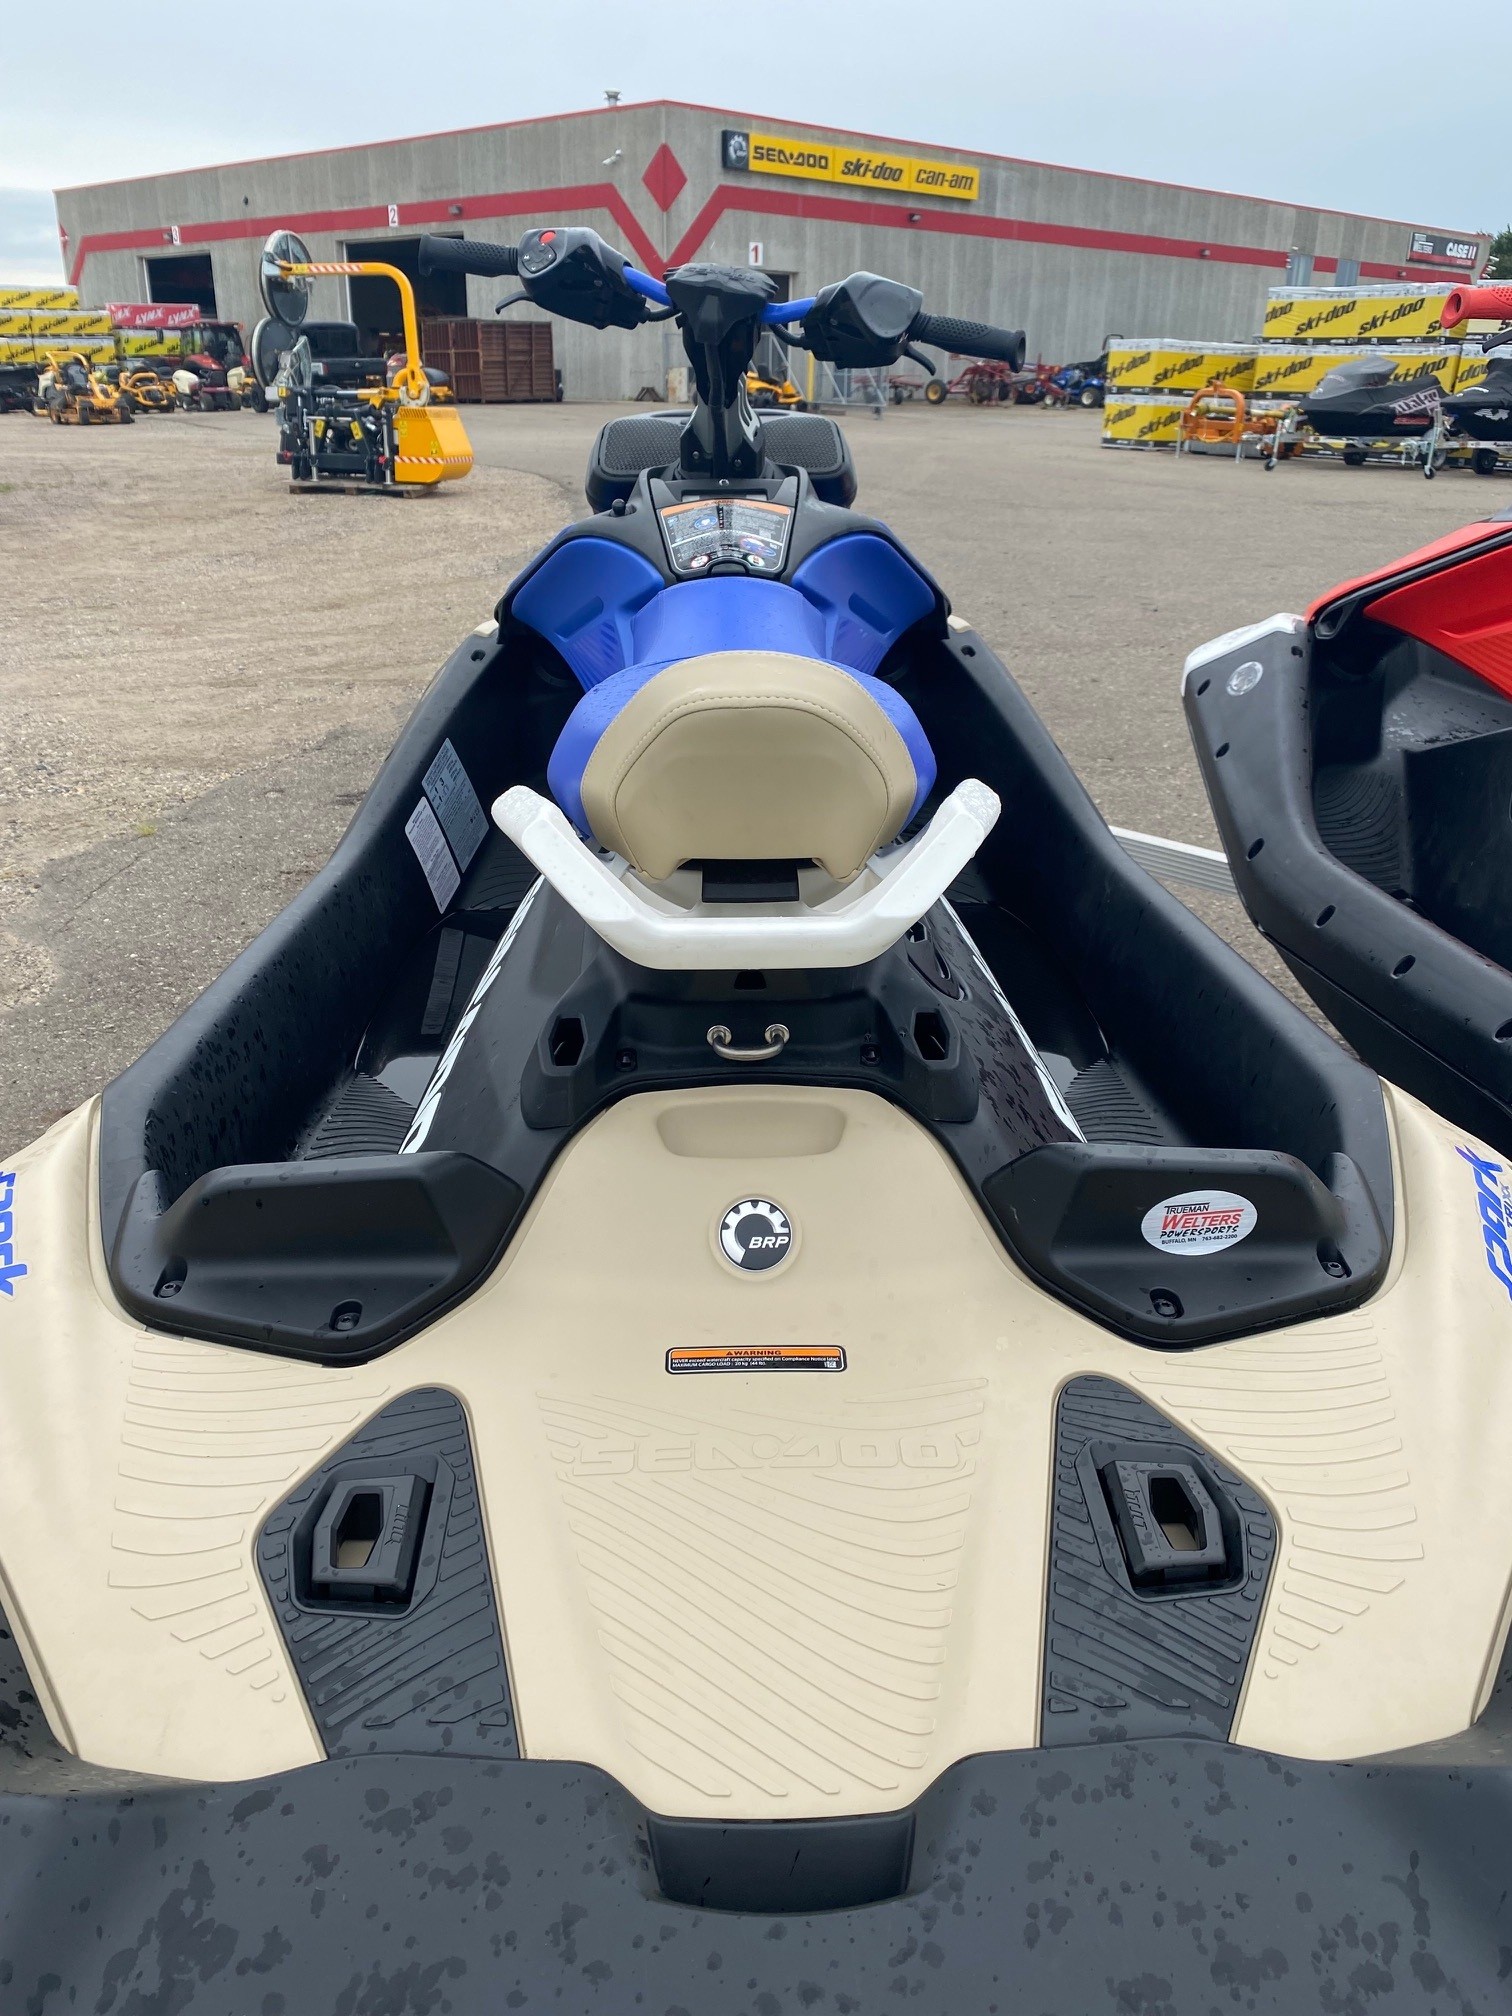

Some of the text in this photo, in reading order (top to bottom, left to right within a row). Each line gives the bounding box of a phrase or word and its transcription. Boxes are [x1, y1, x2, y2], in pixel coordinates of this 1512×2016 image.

[916, 167, 974, 191] can-am
[389, 208, 397, 224] 2
[751, 244, 759, 264] 1
[1446, 242, 1469, 259] CASE
[134, 306, 164, 325] LYNX
[168, 308, 194, 325] LYNX
[1294, 300, 1358, 336] ski-doo
[1357, 298, 1426, 336] ski-doo
[1152, 354, 1205, 386] ski-doo
[1255, 356, 1314, 390] ski-doo
[1164, 1202, 1211, 1215] TRUEMAN
[1161, 1208, 1245, 1231] WELTERS
[1160, 1225, 1239, 1239] POWERSPORTS
[748, 1236, 790, 1249] BRP
